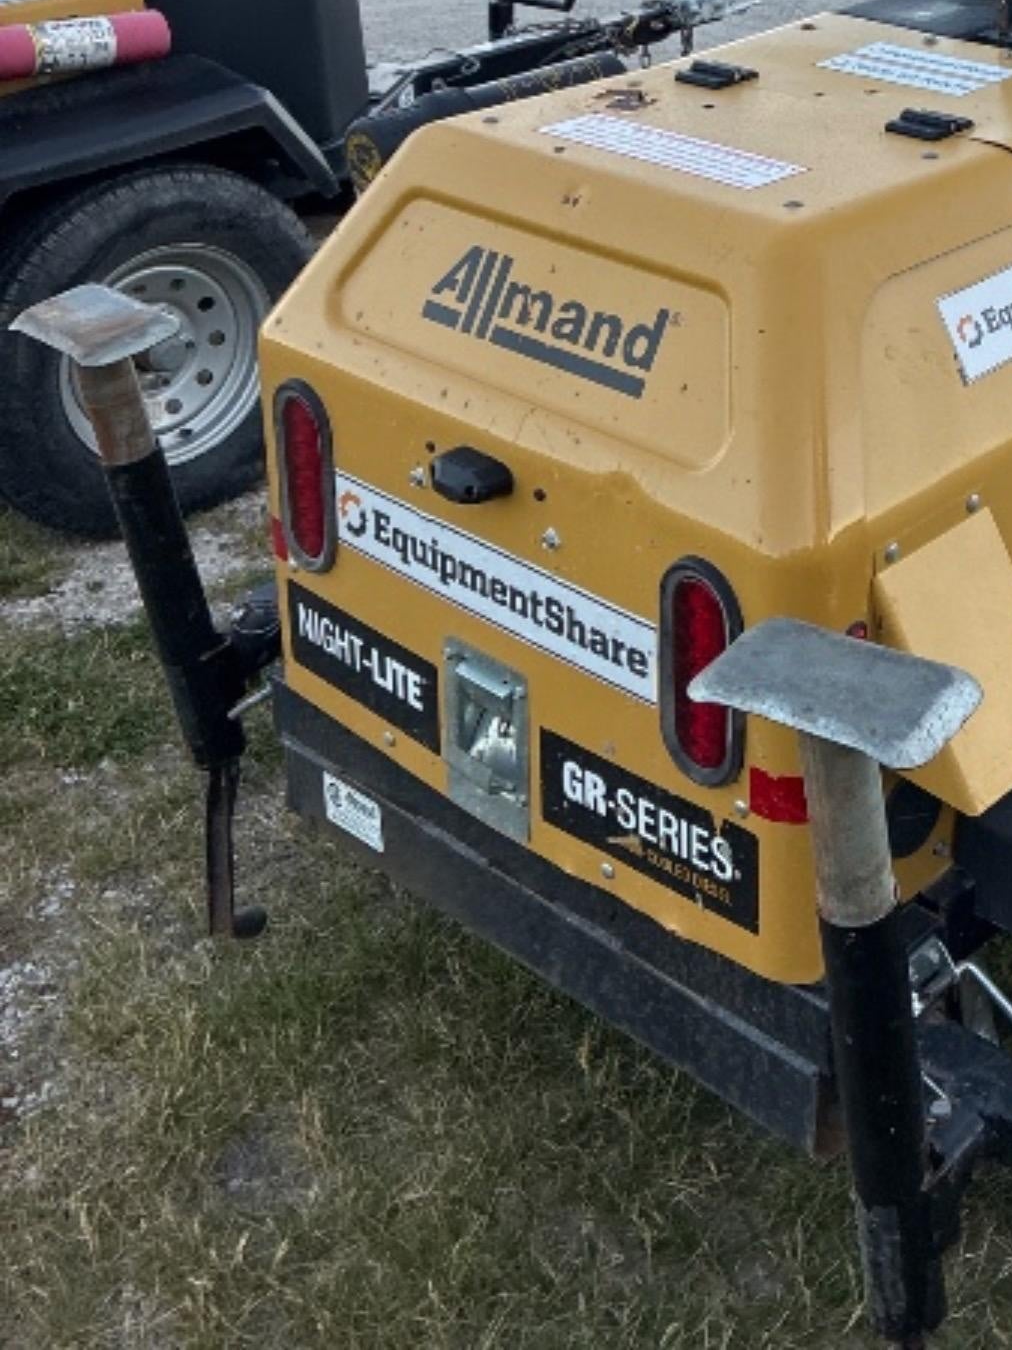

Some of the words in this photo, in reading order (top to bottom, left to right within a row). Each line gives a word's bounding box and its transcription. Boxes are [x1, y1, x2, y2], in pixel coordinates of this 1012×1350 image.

[431, 245, 670, 373] Allmand
[373, 508, 651, 680] EquipmentShare
[297, 602, 424, 712] NIGHT-LITE
[562, 760, 735, 882] GR-SERIES
